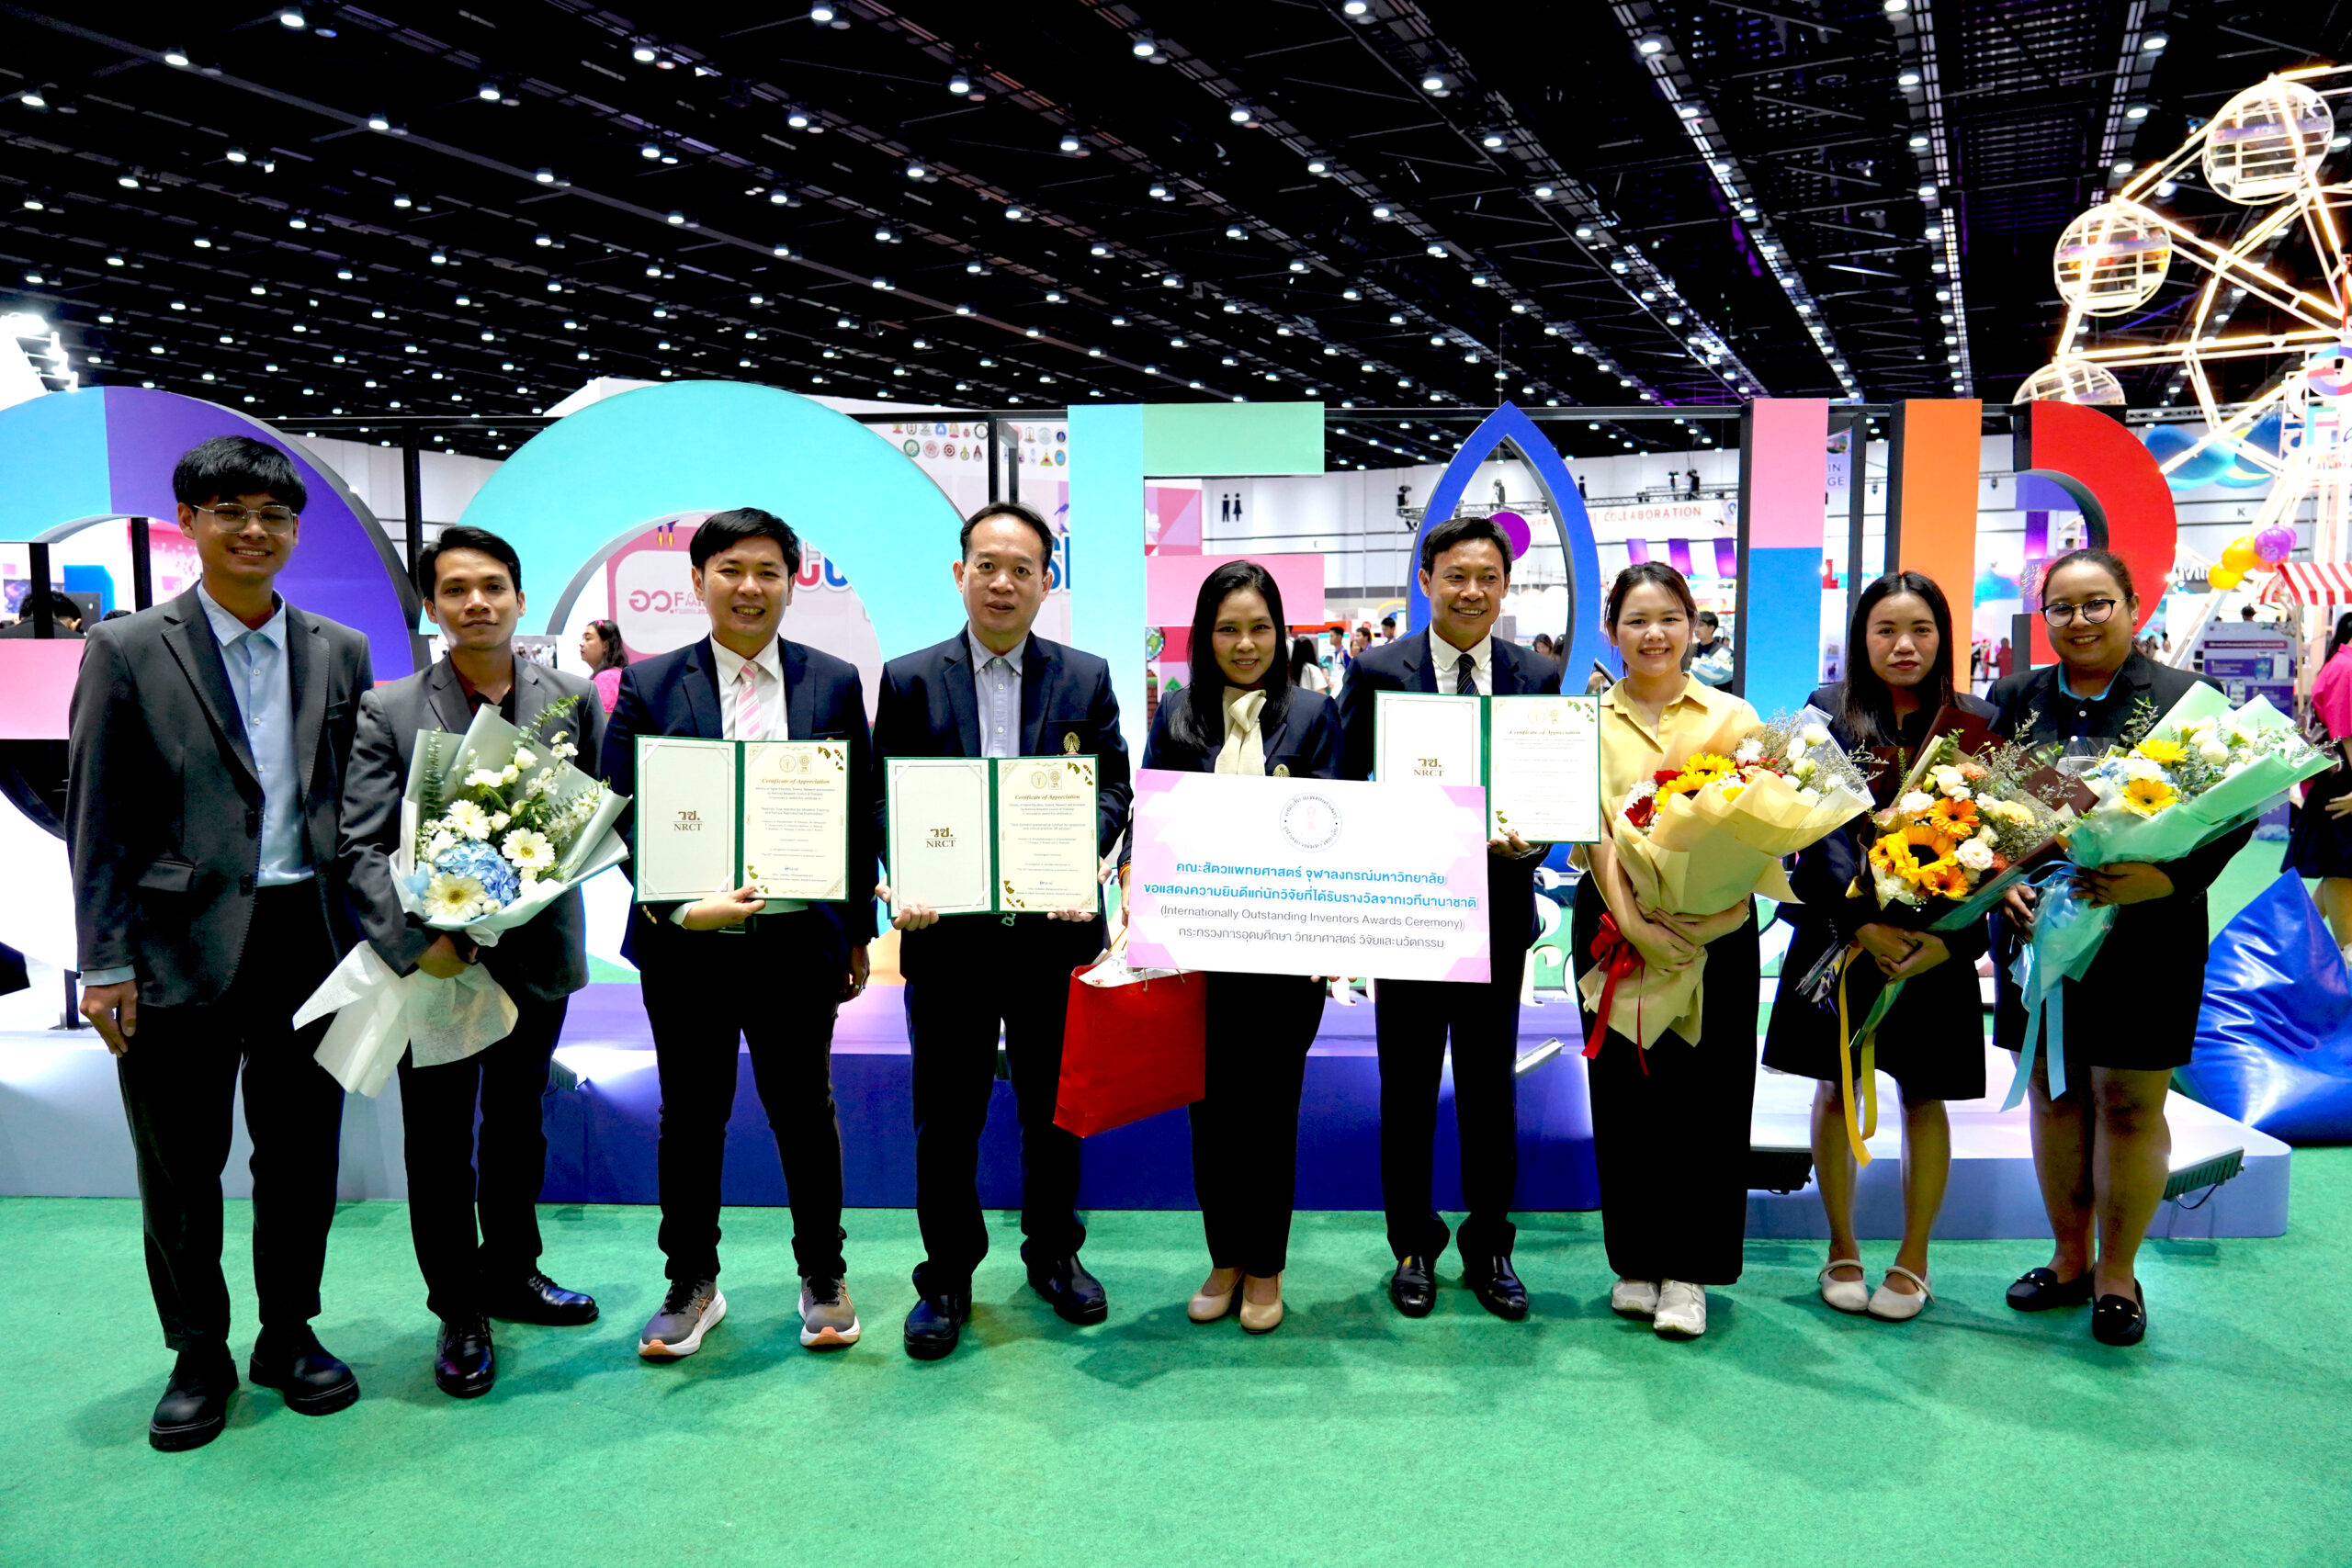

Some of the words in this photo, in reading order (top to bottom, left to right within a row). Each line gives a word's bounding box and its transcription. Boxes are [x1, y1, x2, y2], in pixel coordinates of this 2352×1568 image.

[1604, 506, 1702, 523] COLLABORATION
[1418, 758, 1442, 768] วช.
[1413, 768, 1445, 777] NRCT
[678, 810, 700, 821] วช.
[673, 823, 702, 831] NRCT
[930, 828, 954, 838] วช.
[926, 840, 956, 848] NRCT
[1176, 862, 1302, 878] คณะสัตวแพทยศาสตร์
[1306, 867, 1445, 885] จุฬาลงกรณ์มหาวิทยาลัย
[1144, 883, 1476, 908] ขอแสดงความยินดีแก่นักวิจัยที่ได้รับรางวัลจากเวทีนานาชาติ
[1160, 905, 1238, 920] (Internationally
[1241, 908, 1306, 923] Outstanding
[1310, 912, 1359, 924] Inventors
[1362, 914, 1402, 926] Awards
[1405, 916, 1464, 931] Ceremony)
[1179, 927, 1292, 942] กระทรวงการอุดมศึกษา
[1295, 931, 1356, 945] วิทยาศาสตร์
[1359, 934, 1444, 948] วิจัยและนวัตกรรม
